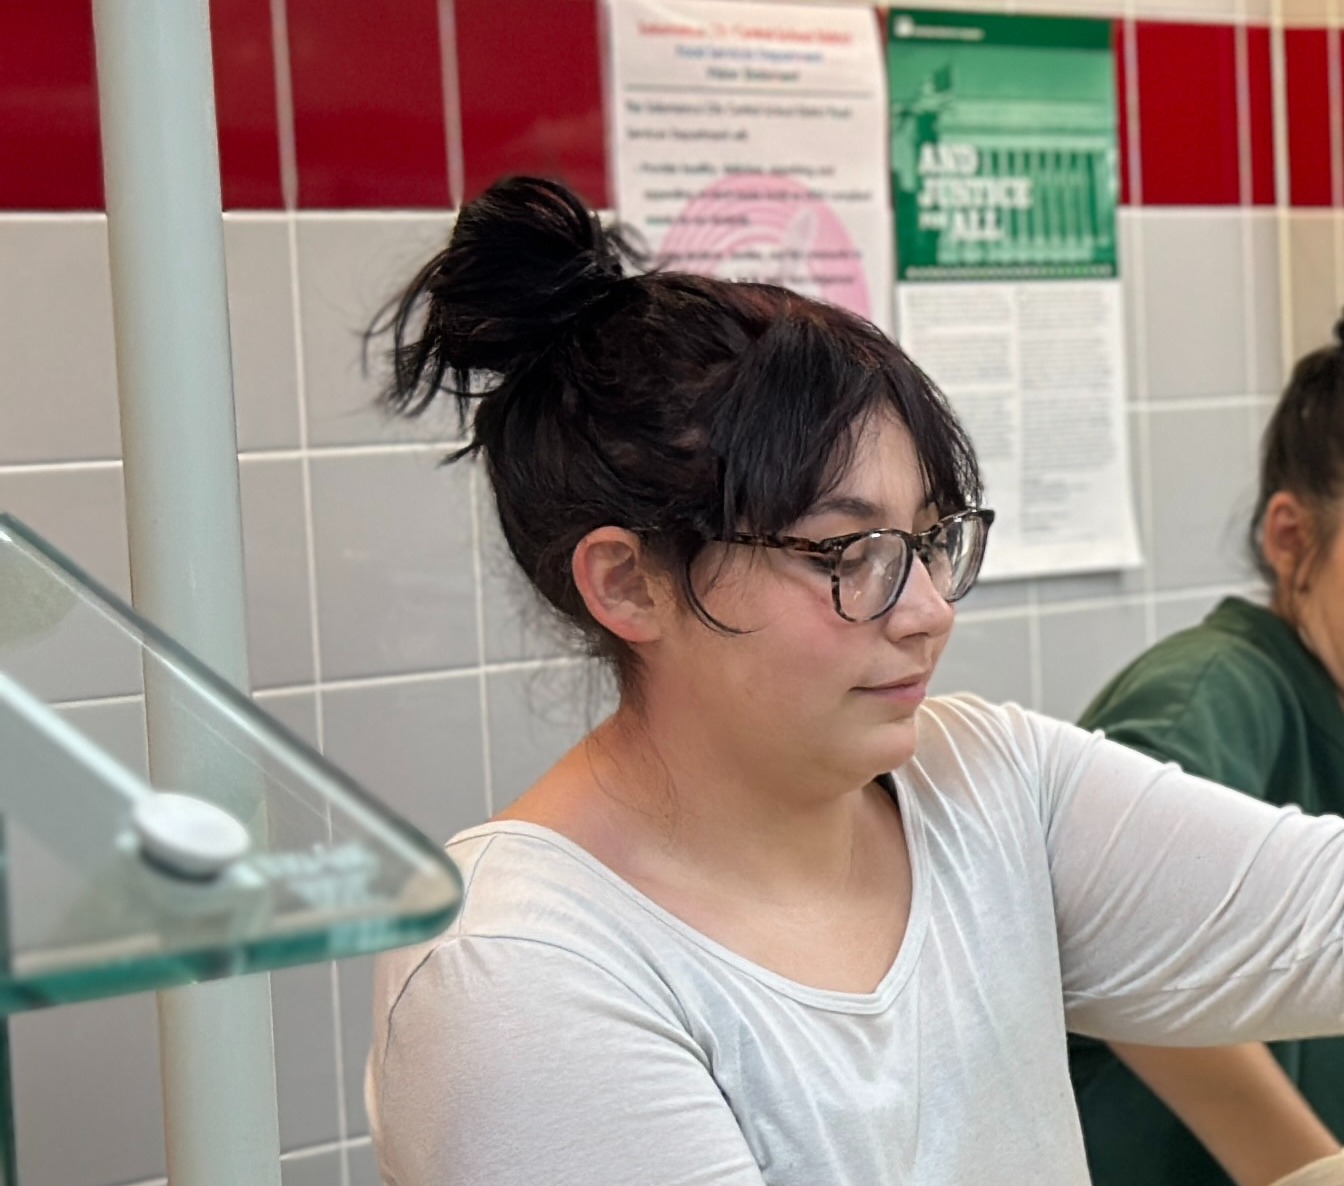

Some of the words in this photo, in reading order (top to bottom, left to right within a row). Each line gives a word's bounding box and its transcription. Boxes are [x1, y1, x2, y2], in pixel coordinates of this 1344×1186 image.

[917, 142, 979, 175] AND
[917, 176, 1032, 208] JUSTICE
[952, 208, 1003, 241] ALL
